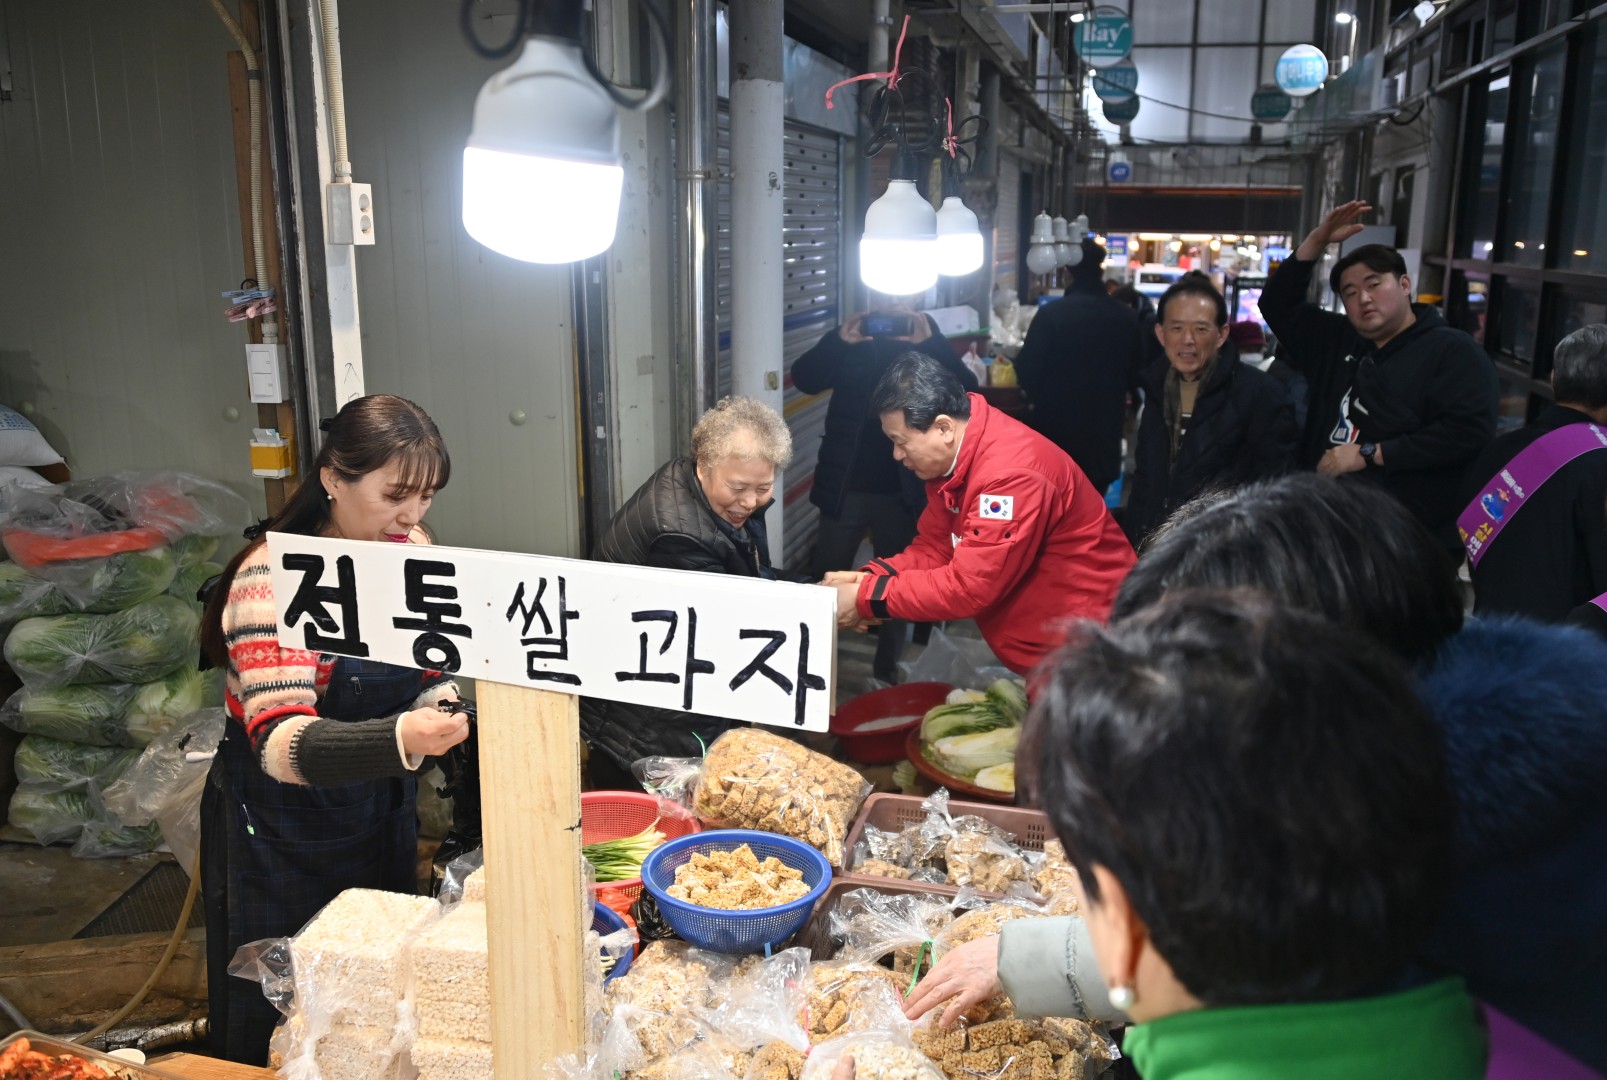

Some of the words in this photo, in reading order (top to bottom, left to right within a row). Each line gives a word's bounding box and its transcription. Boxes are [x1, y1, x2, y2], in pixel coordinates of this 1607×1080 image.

[1083, 22, 1130, 48] Bay
[282, 553, 472, 674] 전통
[506, 576, 583, 687] 쌀
[615, 606, 828, 726] 과자
